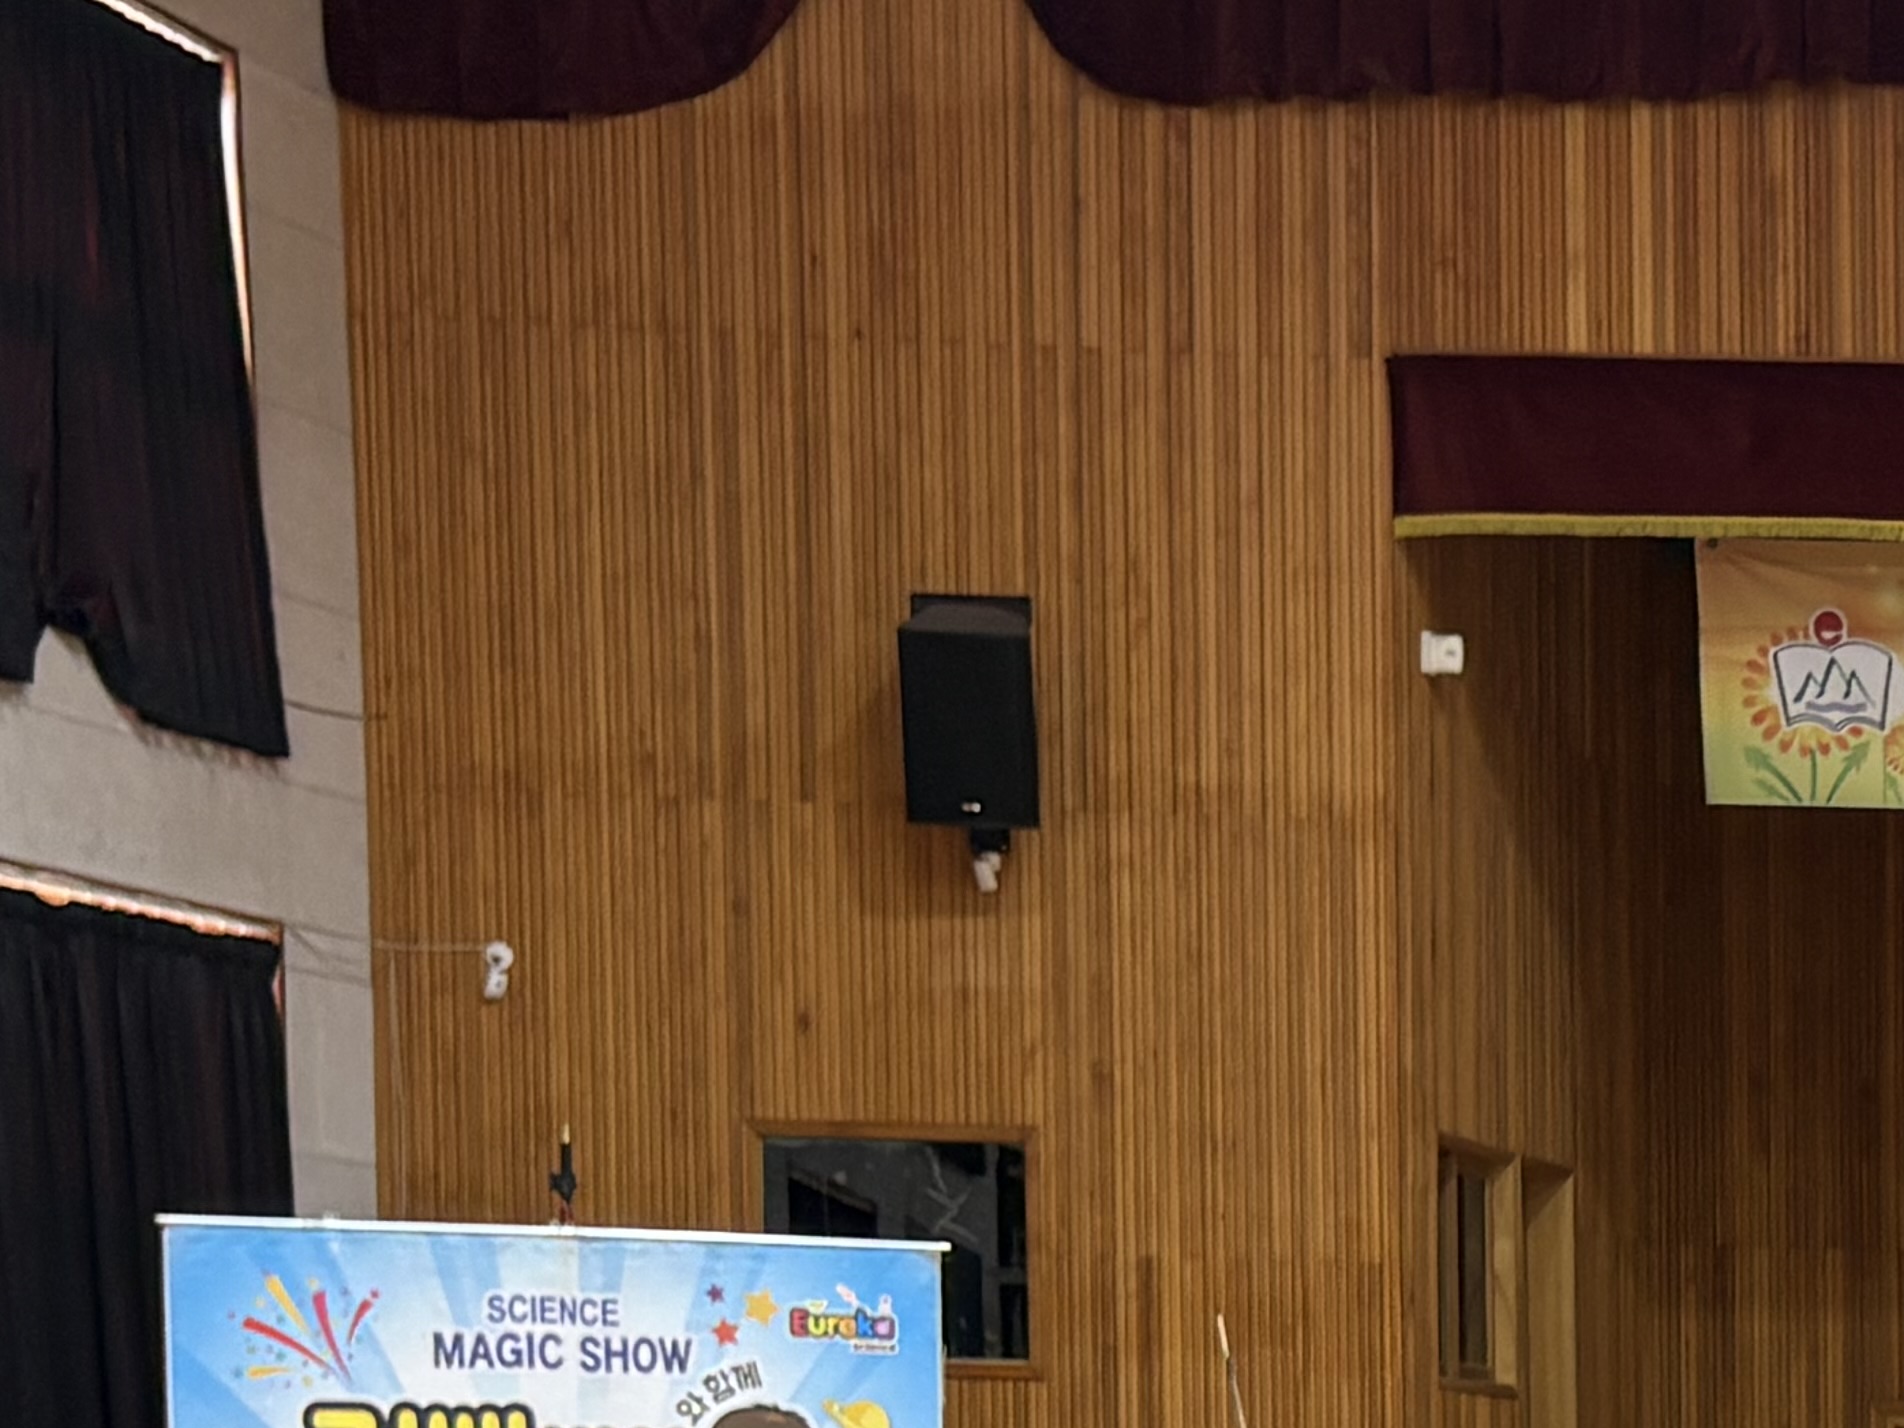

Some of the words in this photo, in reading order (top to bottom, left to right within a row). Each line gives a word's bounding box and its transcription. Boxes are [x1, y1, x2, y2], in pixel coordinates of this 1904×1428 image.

[486, 1294, 619, 1327] SCIENCE
[433, 1331, 564, 1371] MAGIC
[578, 1335, 693, 1376] SHOW
[676, 1393, 709, 1427] 와
[703, 1362, 763, 1402] 함께
